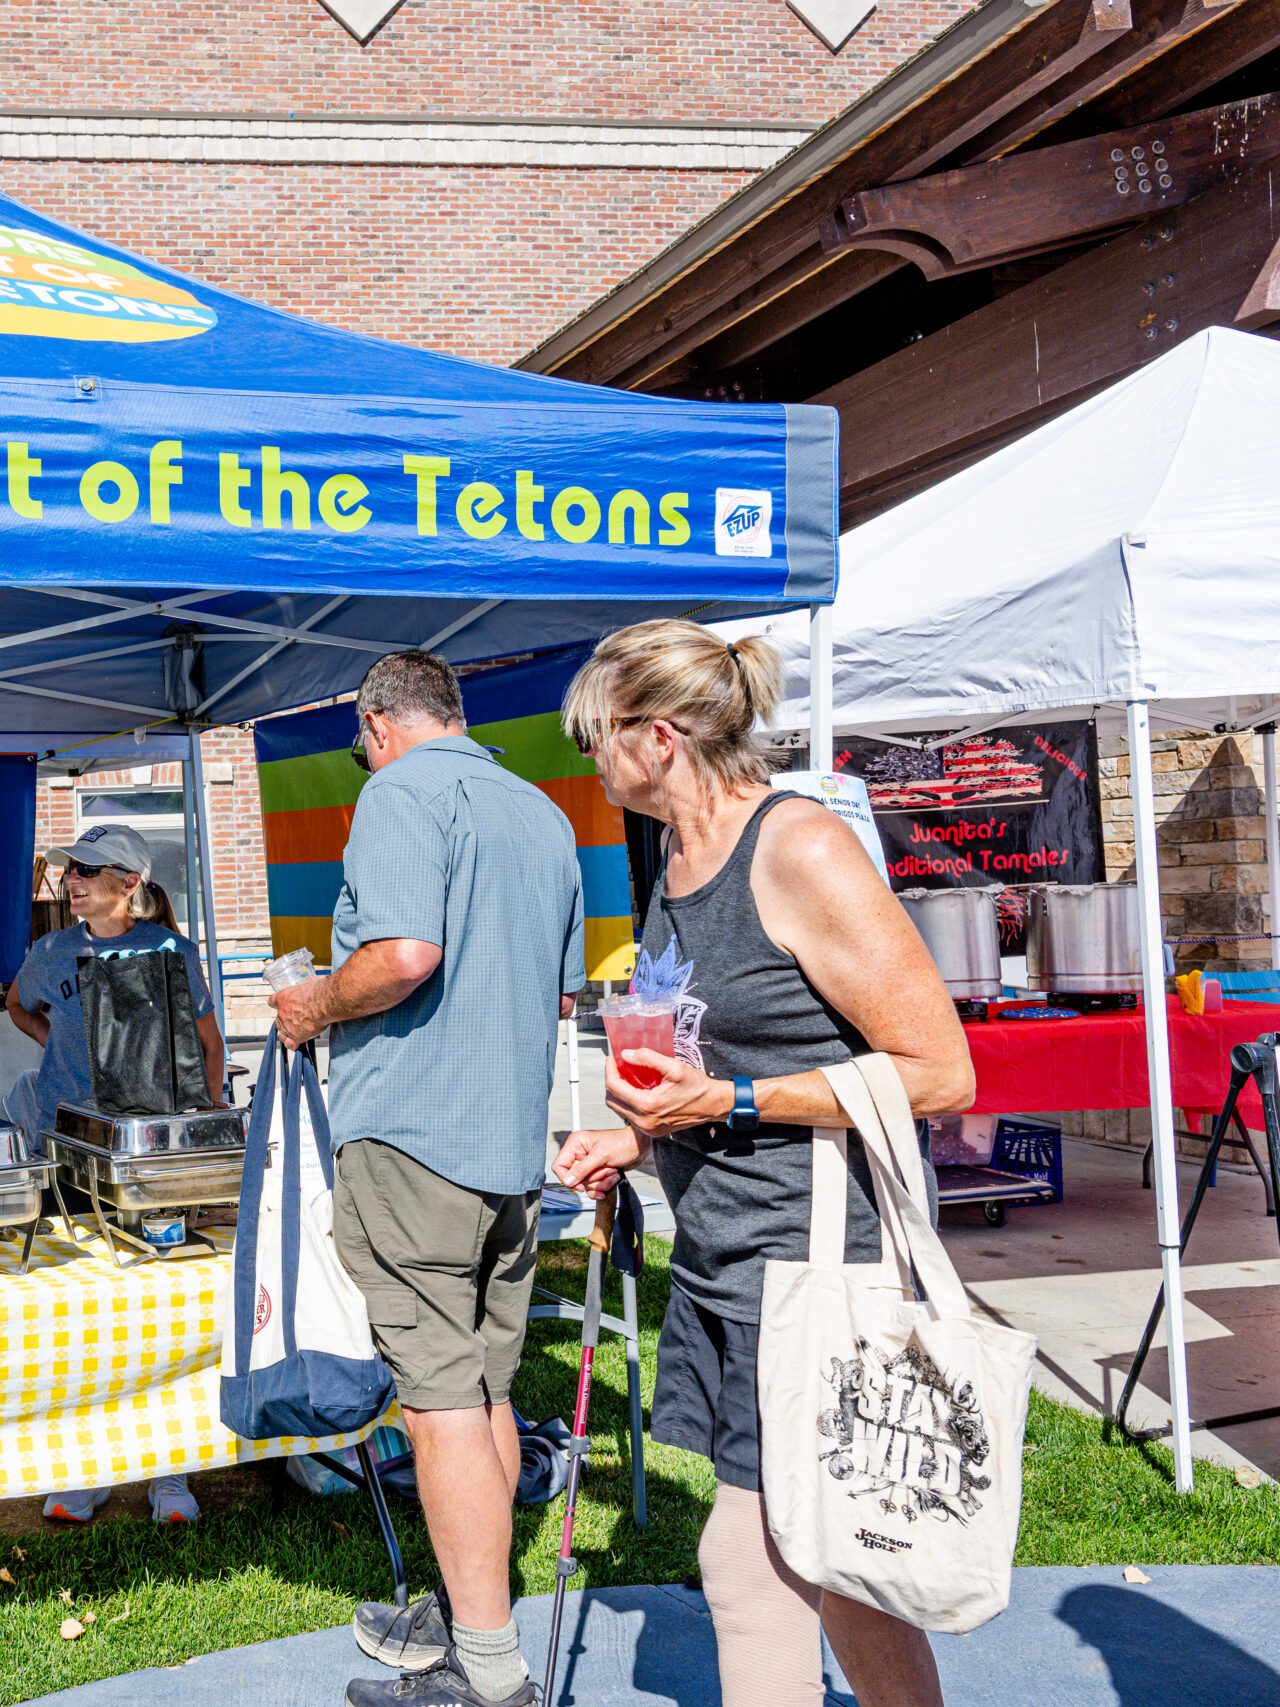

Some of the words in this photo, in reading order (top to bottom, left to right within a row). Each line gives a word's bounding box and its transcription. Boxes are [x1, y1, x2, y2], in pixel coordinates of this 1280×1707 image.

[32, 262, 124, 292] OF
[79, 440, 183, 523] of
[218, 446, 373, 534] the
[403, 454, 691, 545] Tetons
[1034, 735, 1088, 781] DELICIOUS
[909, 817, 1007, 847] Juanita's
[979, 845, 1070, 874] Tamales
[854, 1527, 913, 1550] JACKSON
[862, 1537, 897, 1554] HOLE
